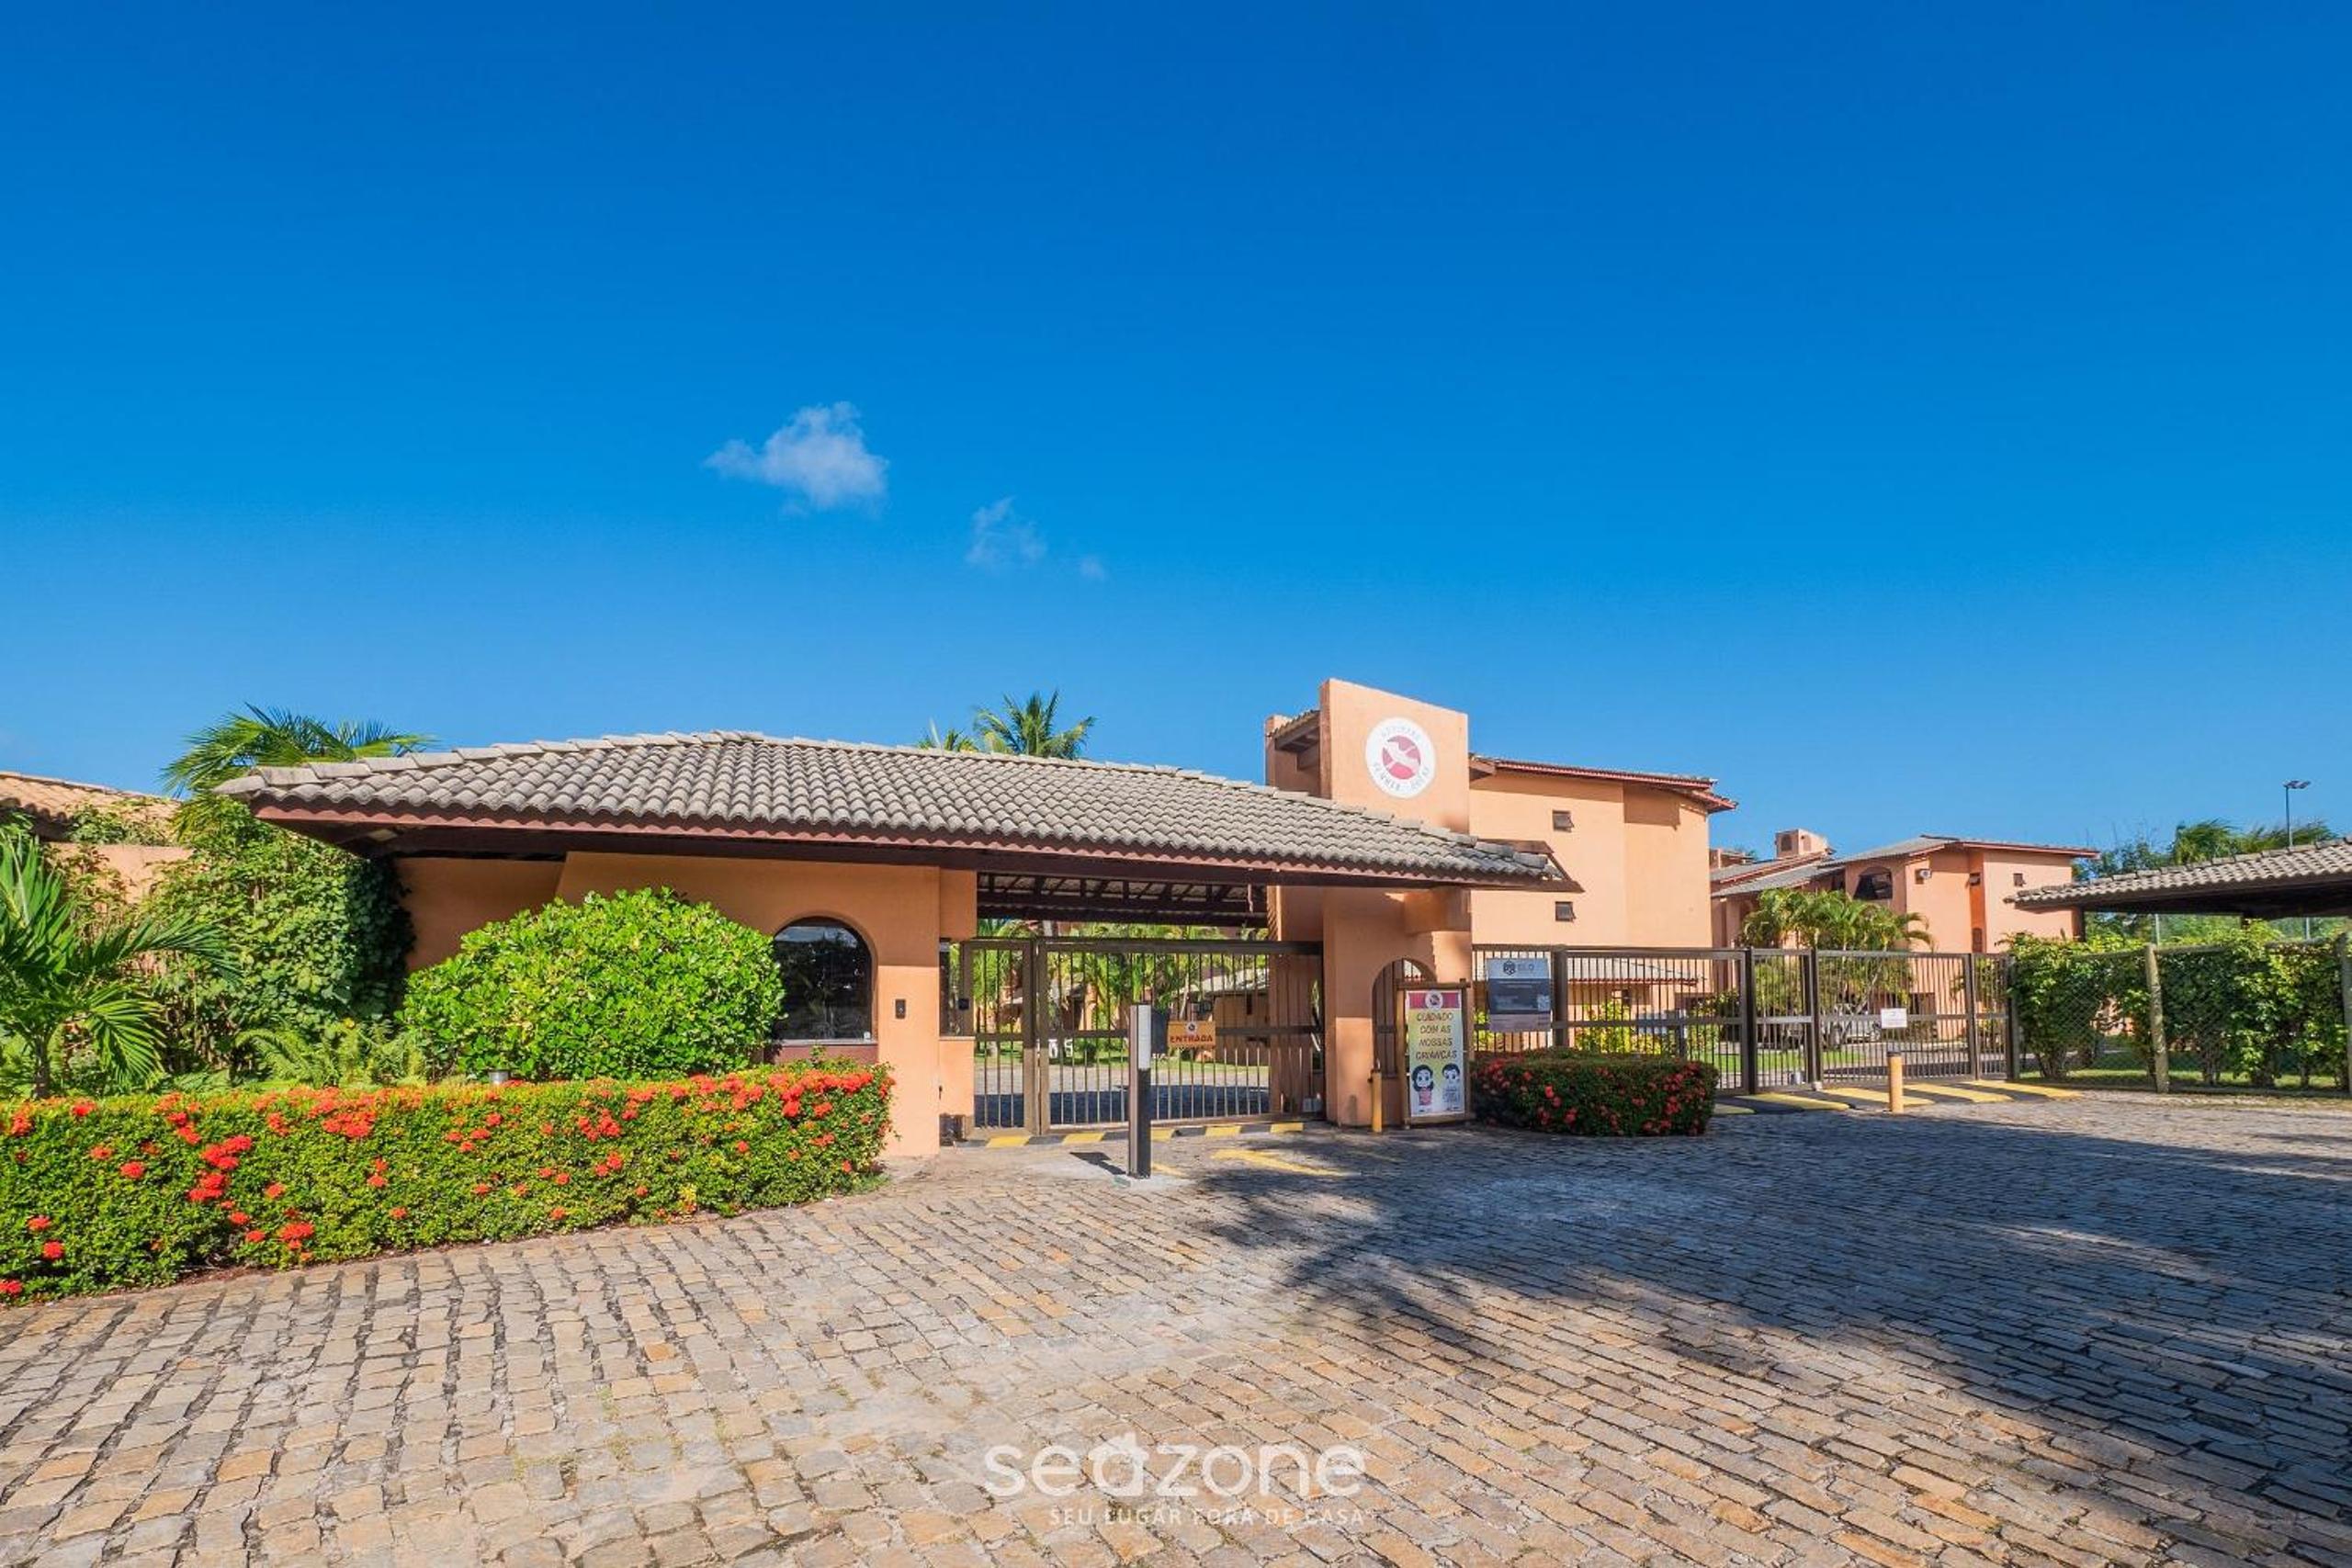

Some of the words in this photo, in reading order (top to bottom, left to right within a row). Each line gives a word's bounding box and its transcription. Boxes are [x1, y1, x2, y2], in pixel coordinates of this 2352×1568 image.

[1417, 1012, 1453, 1021] CUIDADO
[1420, 1025, 1438, 1033] COM
[1441, 1025, 1452, 1033] AS
[1170, 1034, 1213, 1043] ENTRADA
[1419, 1038, 1453, 1046] NOSSAS
